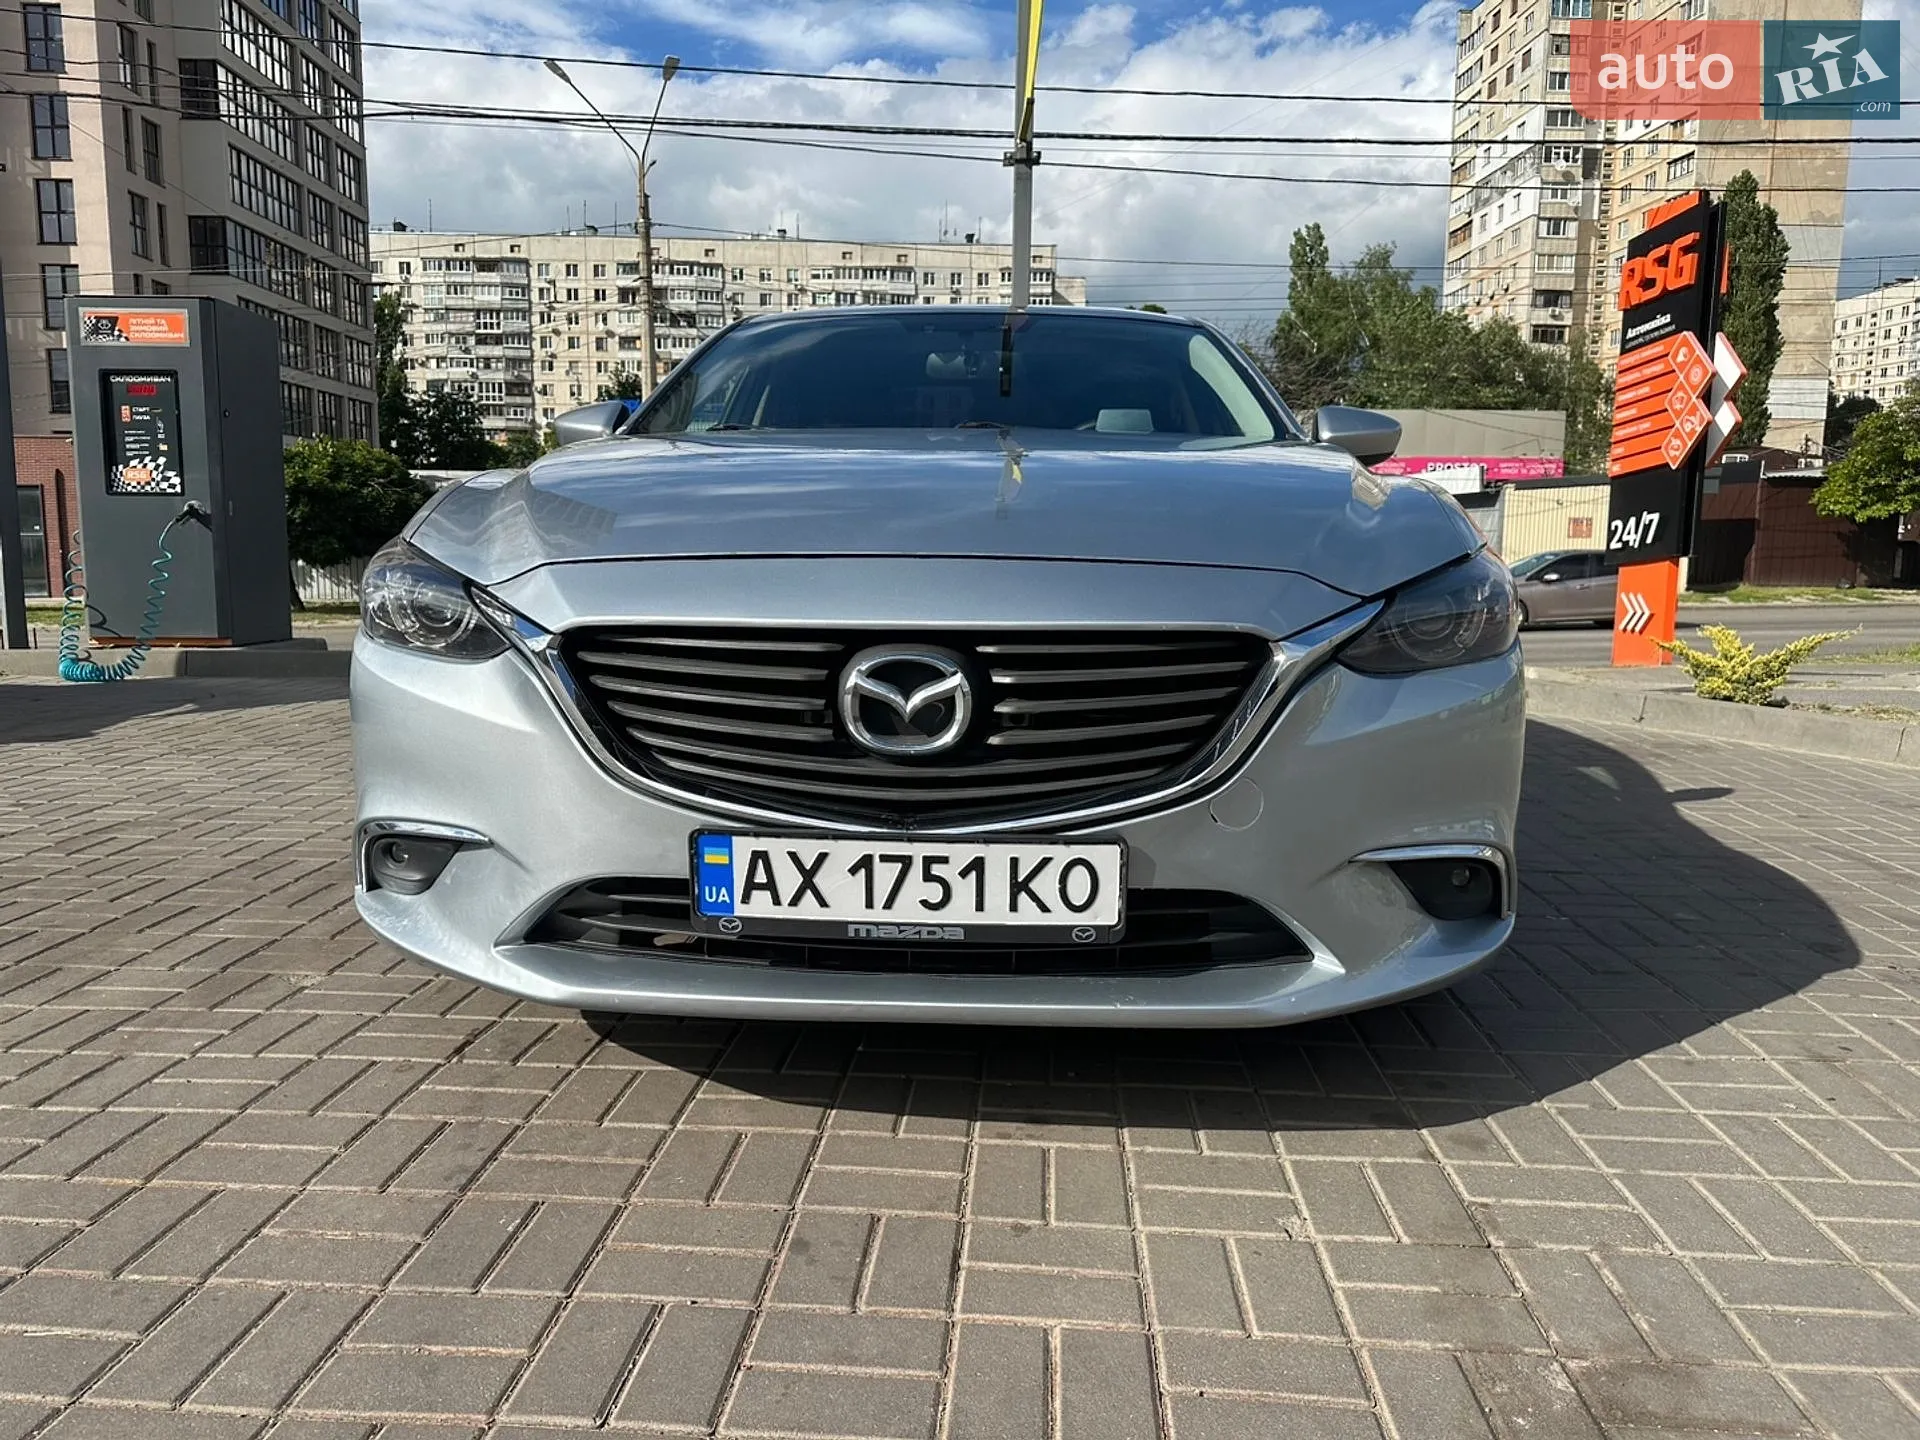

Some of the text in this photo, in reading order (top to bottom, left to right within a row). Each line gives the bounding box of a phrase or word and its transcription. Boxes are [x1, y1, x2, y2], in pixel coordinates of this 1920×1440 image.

[1619, 232, 1700, 310] RSG
[1609, 510, 1660, 550] 24/7
[704, 886, 730, 905] UA
[739, 849, 1100, 914] AX 1751 KO
